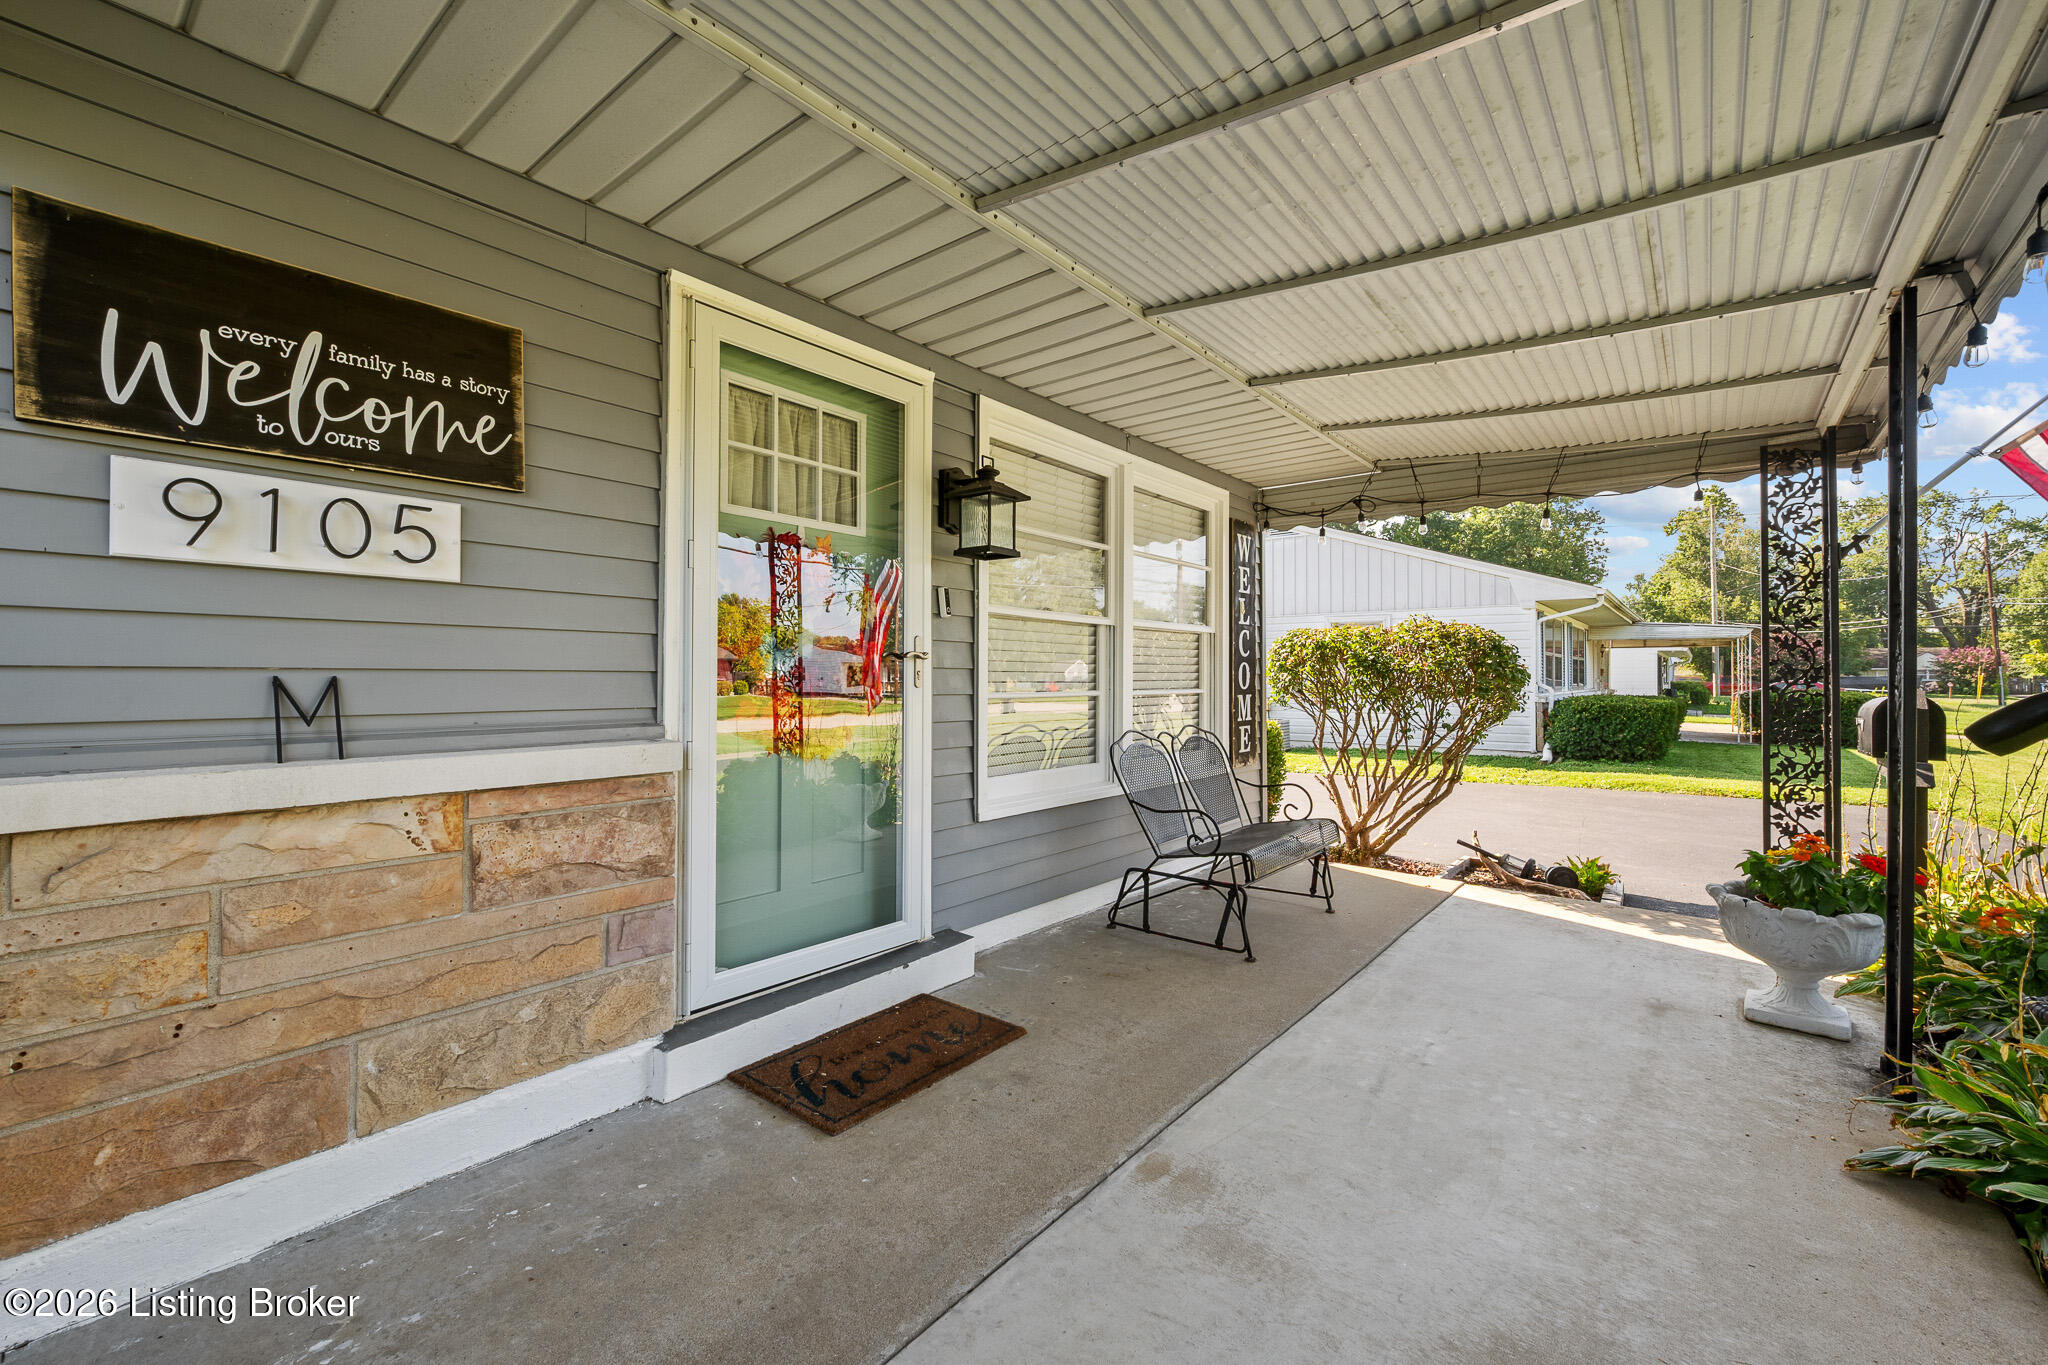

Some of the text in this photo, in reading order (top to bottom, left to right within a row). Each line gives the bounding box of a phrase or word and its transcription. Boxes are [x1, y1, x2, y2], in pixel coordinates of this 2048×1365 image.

[101, 308, 513, 456] Welcome
[218, 325, 511, 405] every family has a story
[256, 413, 381, 452] to ours
[162, 477, 437, 564] 9105
[1236, 533, 1252, 753] WELCOME
[272, 675, 344, 764] M
[790, 1012, 982, 1107] home
